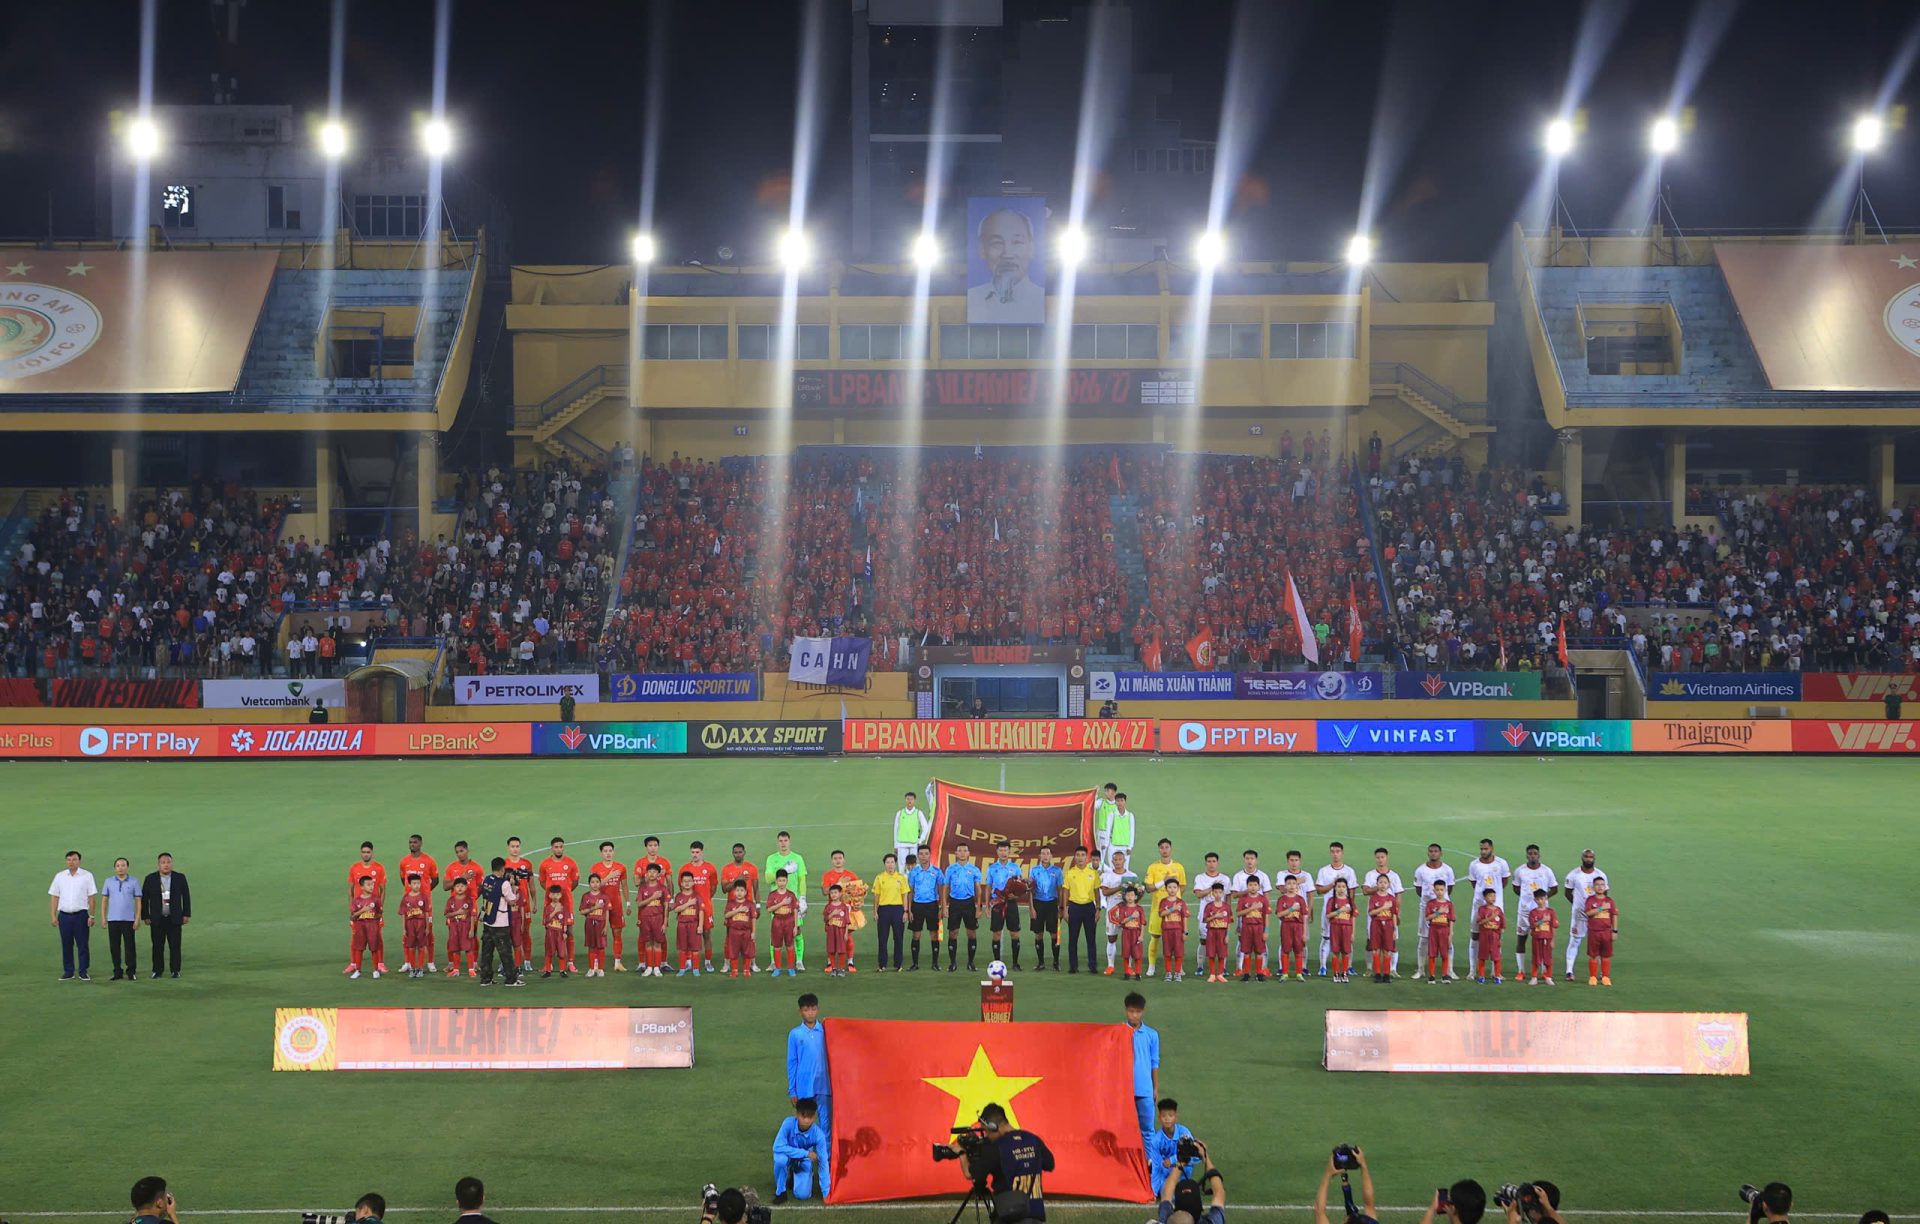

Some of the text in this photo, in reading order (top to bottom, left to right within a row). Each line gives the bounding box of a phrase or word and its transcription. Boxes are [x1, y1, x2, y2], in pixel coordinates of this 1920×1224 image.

[0, 291, 75, 315] NG AN
[48, 341, 76, 356] FC
[829, 372, 912, 405] LPBAN
[737, 426, 746, 435] 11
[1251, 426, 1261, 435] 12
[485, 684, 585, 698] PETROLIMEX
[642, 679, 751, 696] DONGLUCSPORT.VN
[1119, 674, 1232, 692] XI MĂNG XUÂN THÀNH
[1449, 682, 1513, 697] VPBank
[1687, 682, 1795, 696] Vietnam Airlines
[241, 695, 310, 706] Vietcombank
[18, 733, 53, 748] Plus
[112, 732, 200, 755] FPT Play
[259, 729, 364, 751] JOGARBOLA
[408, 733, 479, 750] LPBank
[588, 733, 658, 750] VPBank
[772, 726, 828, 744] SPORT
[851, 722, 941, 749] LPBANK
[1081, 721, 1147, 749] 2026/27
[1210, 727, 1298, 750] FPT Play
[1369, 728, 1457, 743] VINFAST
[1531, 731, 1603, 748] VPBank
[955, 823, 1057, 847] LPBank
[635, 1022, 678, 1034] LPBank
[1330, 1026, 1374, 1037] LPBank
